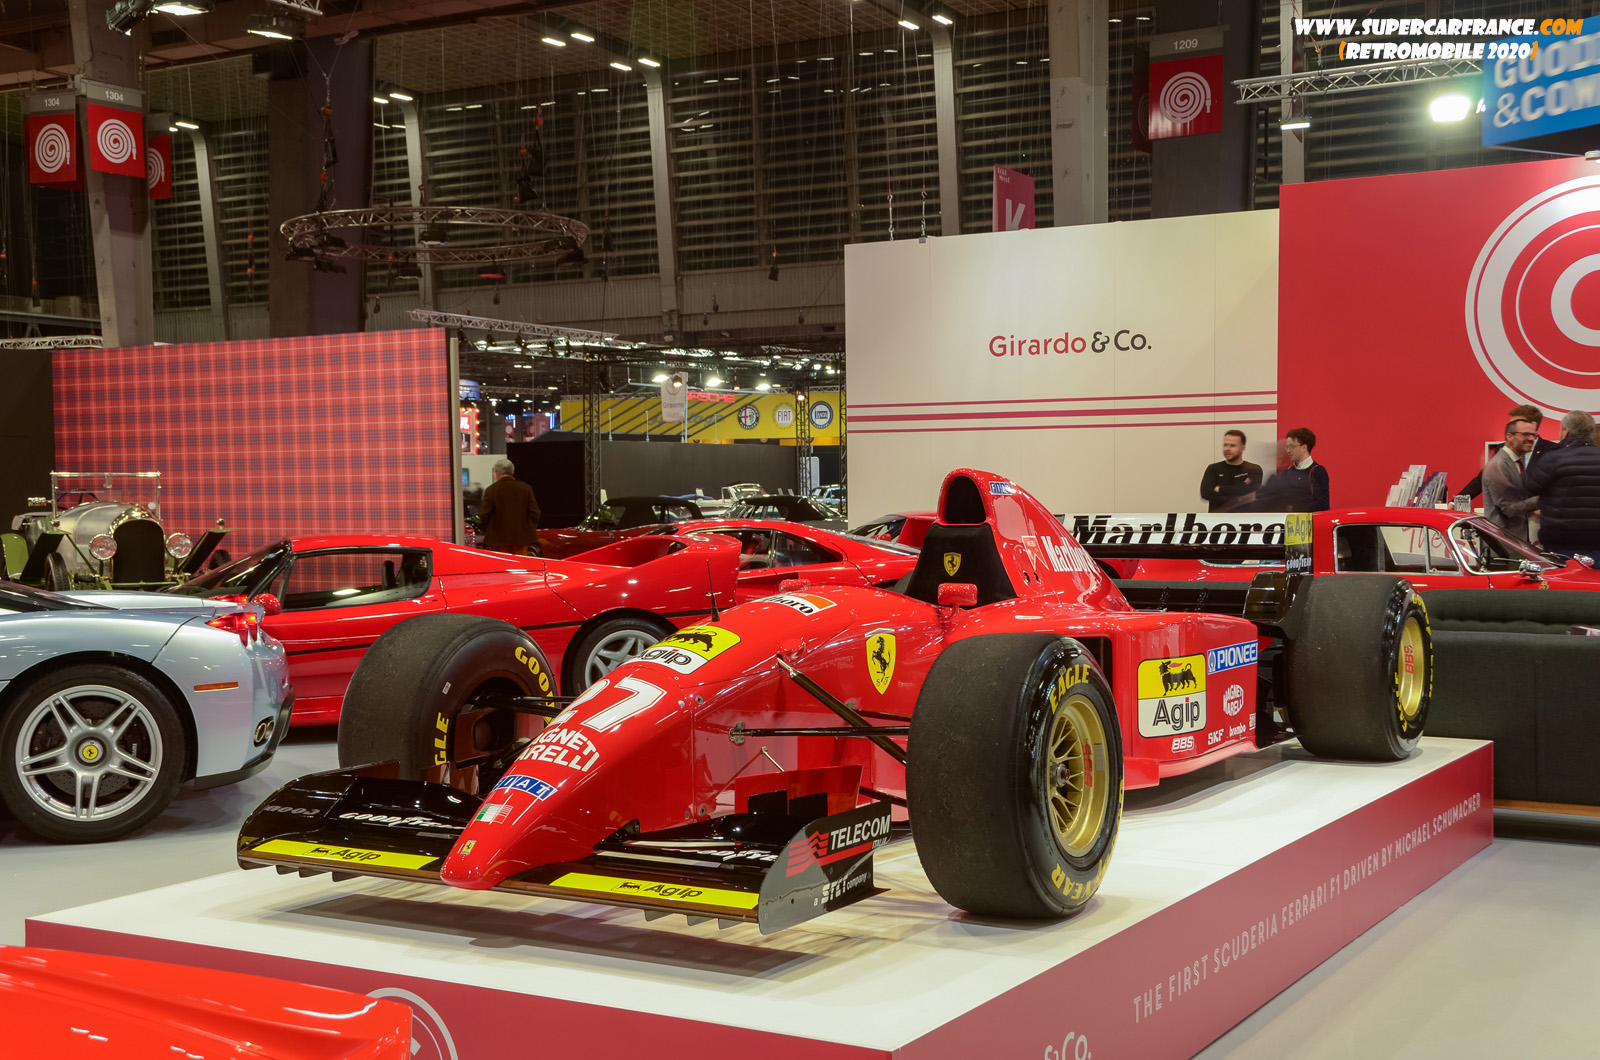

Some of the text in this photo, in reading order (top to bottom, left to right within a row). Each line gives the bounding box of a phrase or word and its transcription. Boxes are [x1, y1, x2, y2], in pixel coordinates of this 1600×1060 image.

[1173, 38, 1198, 50] 1209
[44, 97, 60, 107] 1304
[104, 90, 124, 102] 1304
[989, 332, 1087, 357] Girardo
[777, 410, 791, 422] FIAT
[1072, 513, 1287, 545] Marlboro
[1217, 643, 1258, 669] PIONEE
[1049, 663, 1091, 715] EAGLE
[1152, 696, 1200, 731] Agip
[1172, 736, 1195, 752] BBS
[1207, 728, 1225, 746] SKF
[830, 814, 892, 850] TELECOM
[332, 849, 382, 862] Agip
[847, 872, 868, 890] company
[643, 884, 704, 900] Agip
[1133, 792, 1481, 1024] THE FIRST SCUDERIA FERRARI F1 DRIVEN BY MICHAEL SCHUMACHER
